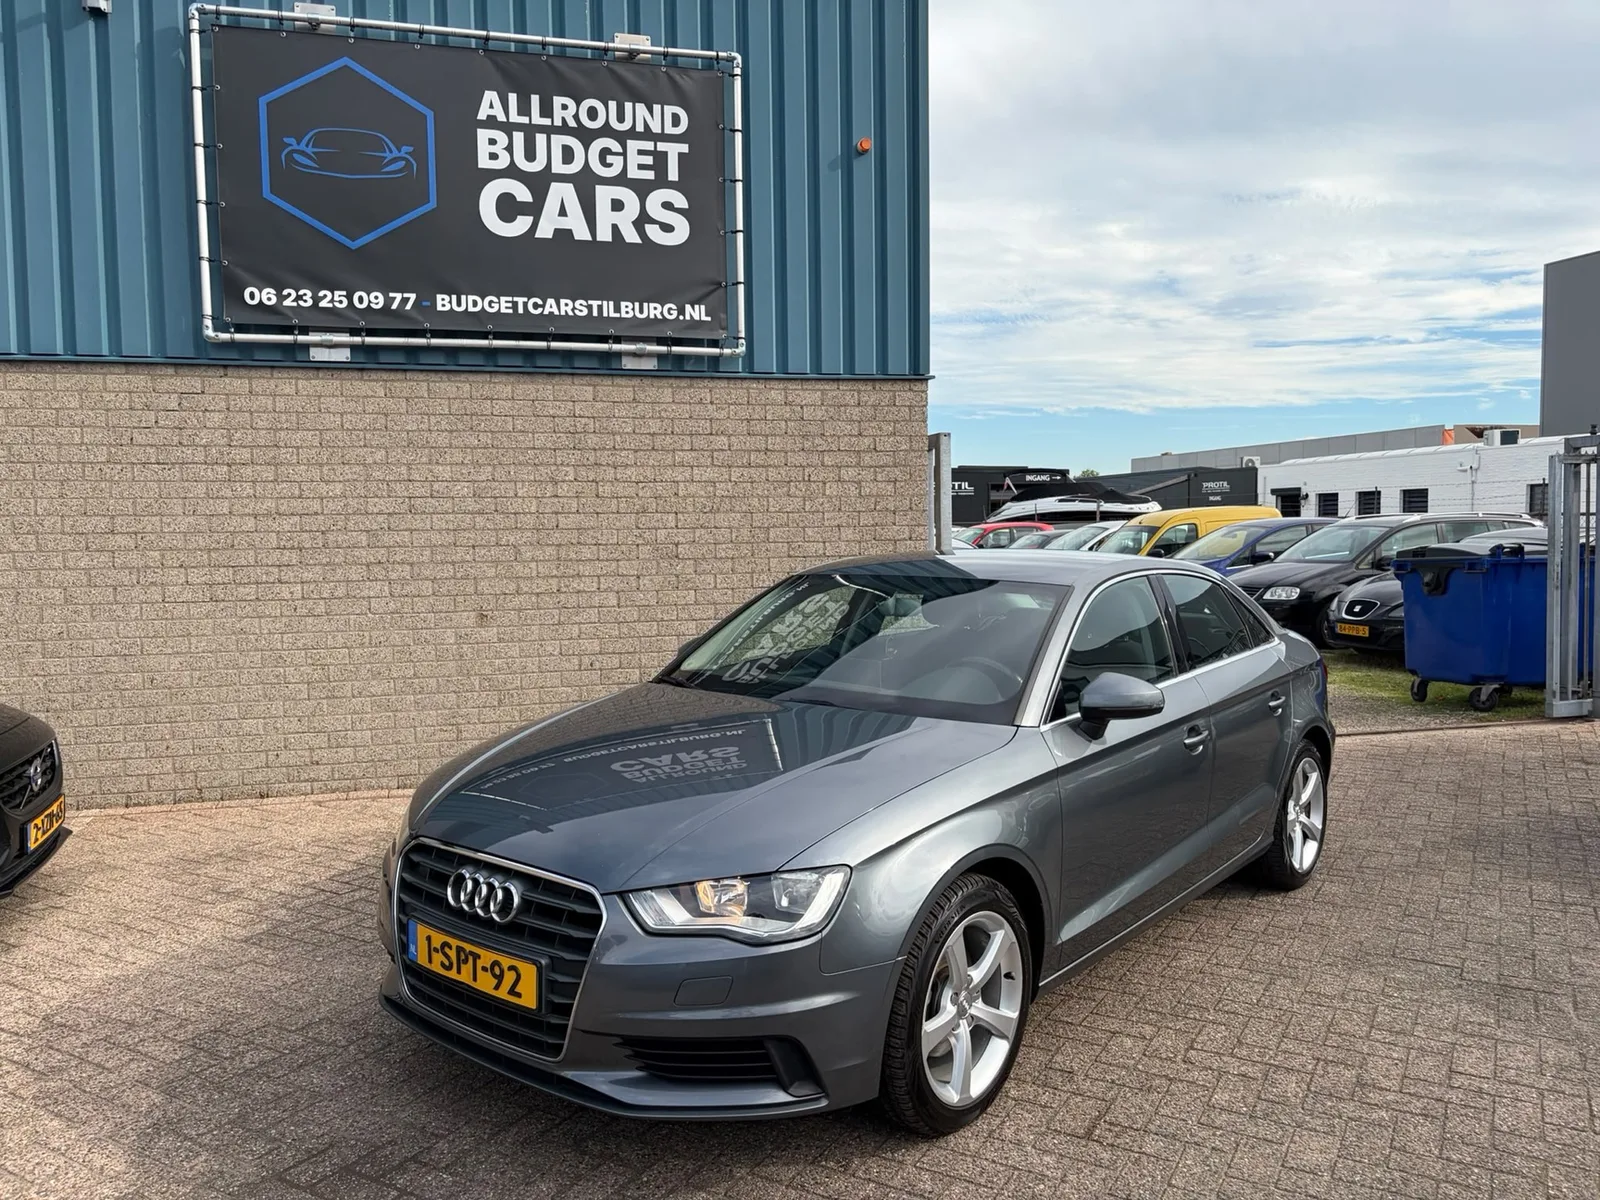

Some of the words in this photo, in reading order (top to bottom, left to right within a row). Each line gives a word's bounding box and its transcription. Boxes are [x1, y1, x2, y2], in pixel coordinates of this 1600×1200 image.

[477, 90, 689, 135] ALLROUND
[477, 128, 689, 182] BUDGET
[478, 178, 691, 247] CARS
[243, 286, 277, 306] 06
[282, 288, 313, 307] 23
[318, 290, 348, 308] 25
[353, 291, 384, 309] 09
[388, 292, 417, 310] 77
[435, 294, 712, 321] BUDGETCARSTILBURG.NL
[951, 481, 975, 490] TIL
[1025, 474, 1050, 482] INGANG
[425, 934, 523, 999] 1-SPT-92
